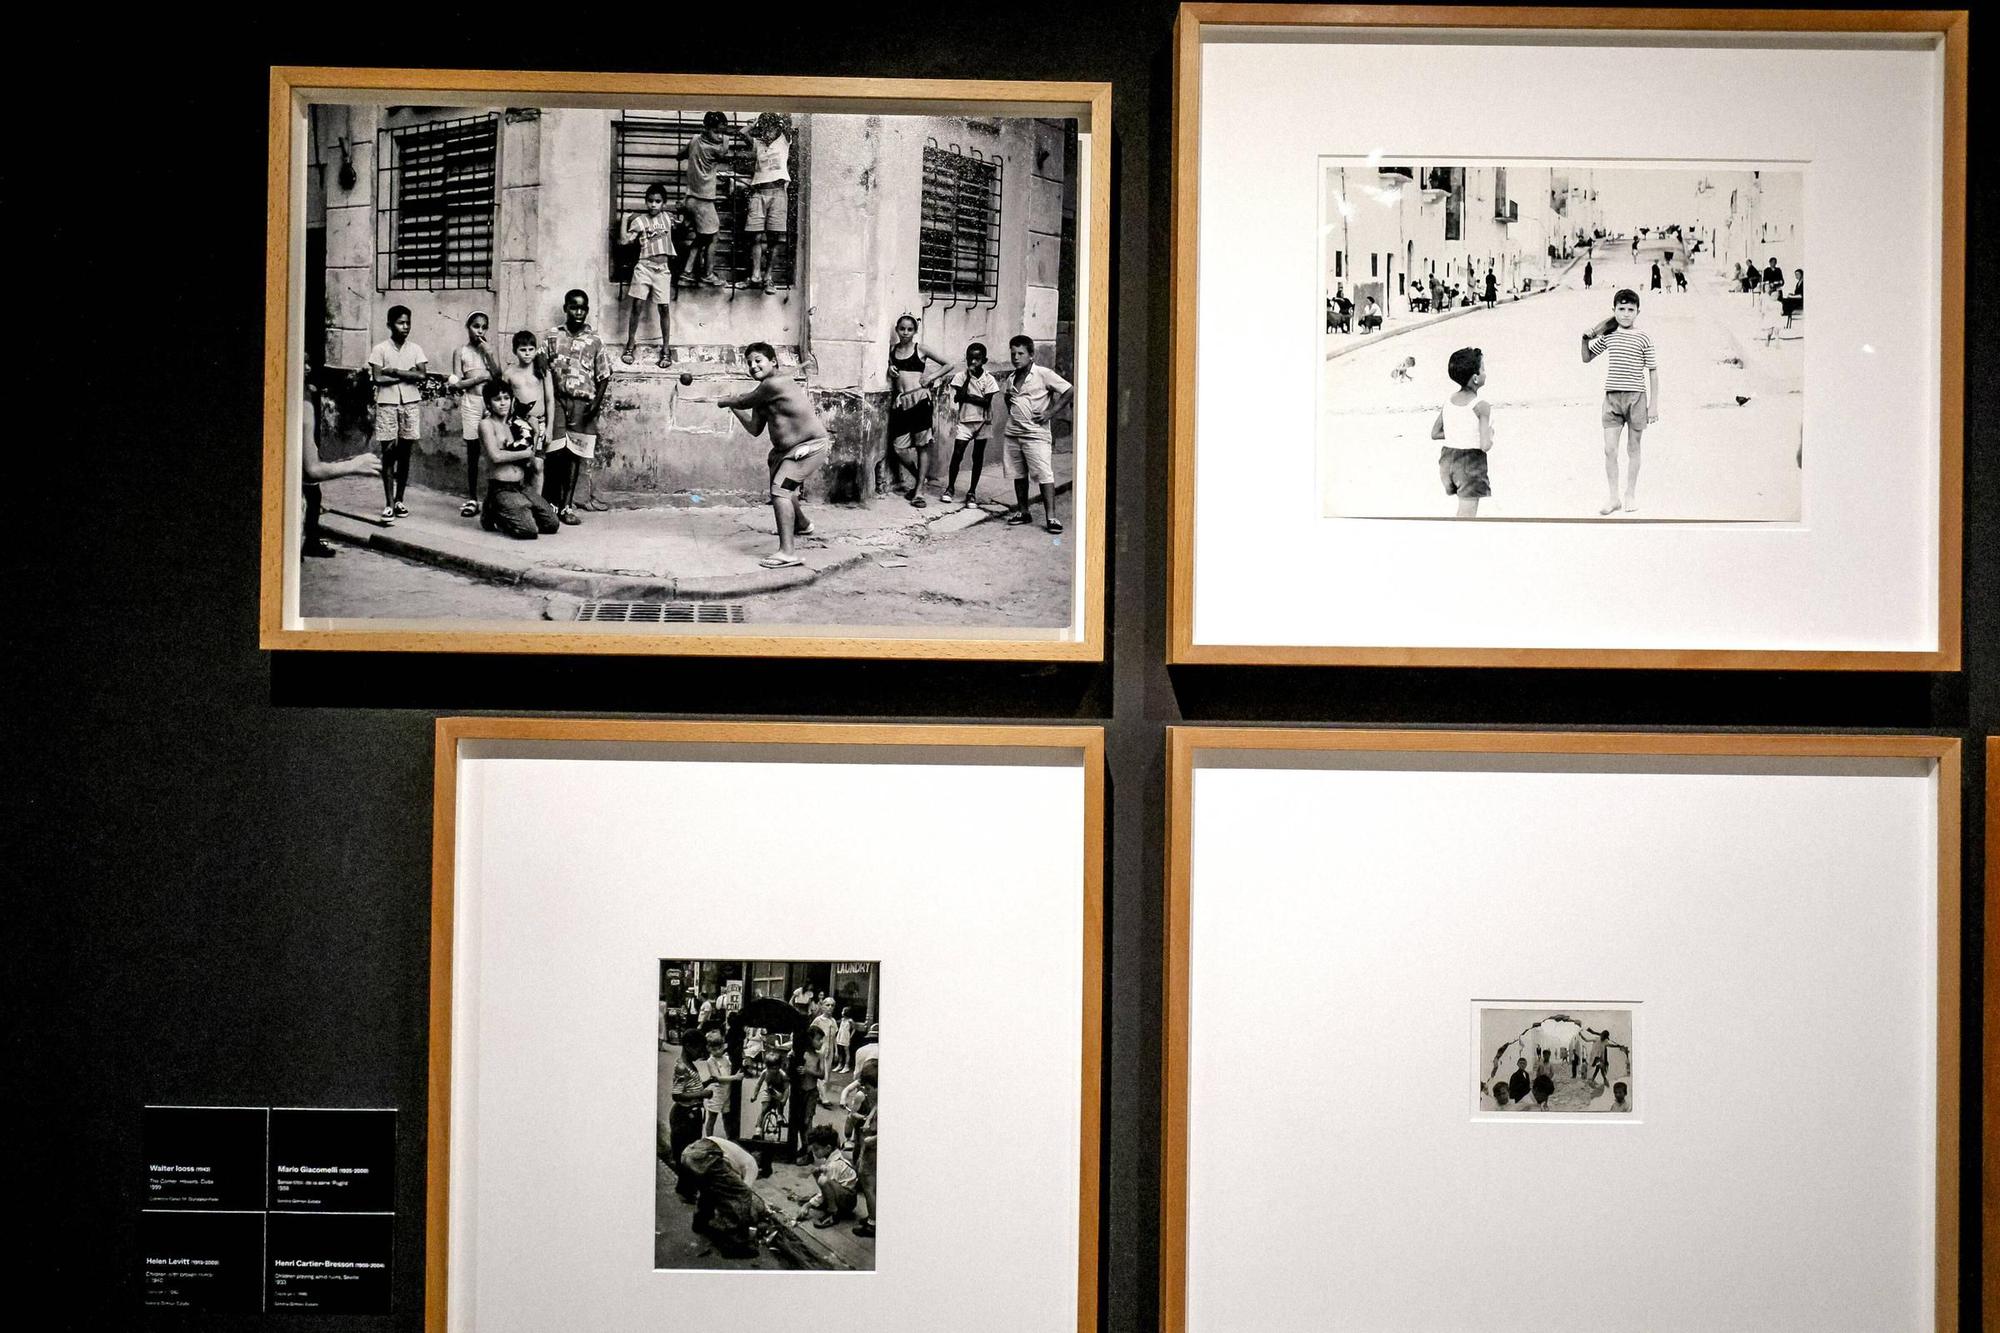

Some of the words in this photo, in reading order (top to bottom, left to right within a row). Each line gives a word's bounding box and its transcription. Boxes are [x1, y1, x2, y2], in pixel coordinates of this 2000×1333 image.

[149, 1164, 174, 1172] Walter
[277, 1165, 299, 1173] Mario
[300, 1166, 338, 1174] Giacomelli
[275, 1259, 295, 1267] Henri
[296, 1260, 354, 1268] Cartier-Bresson
